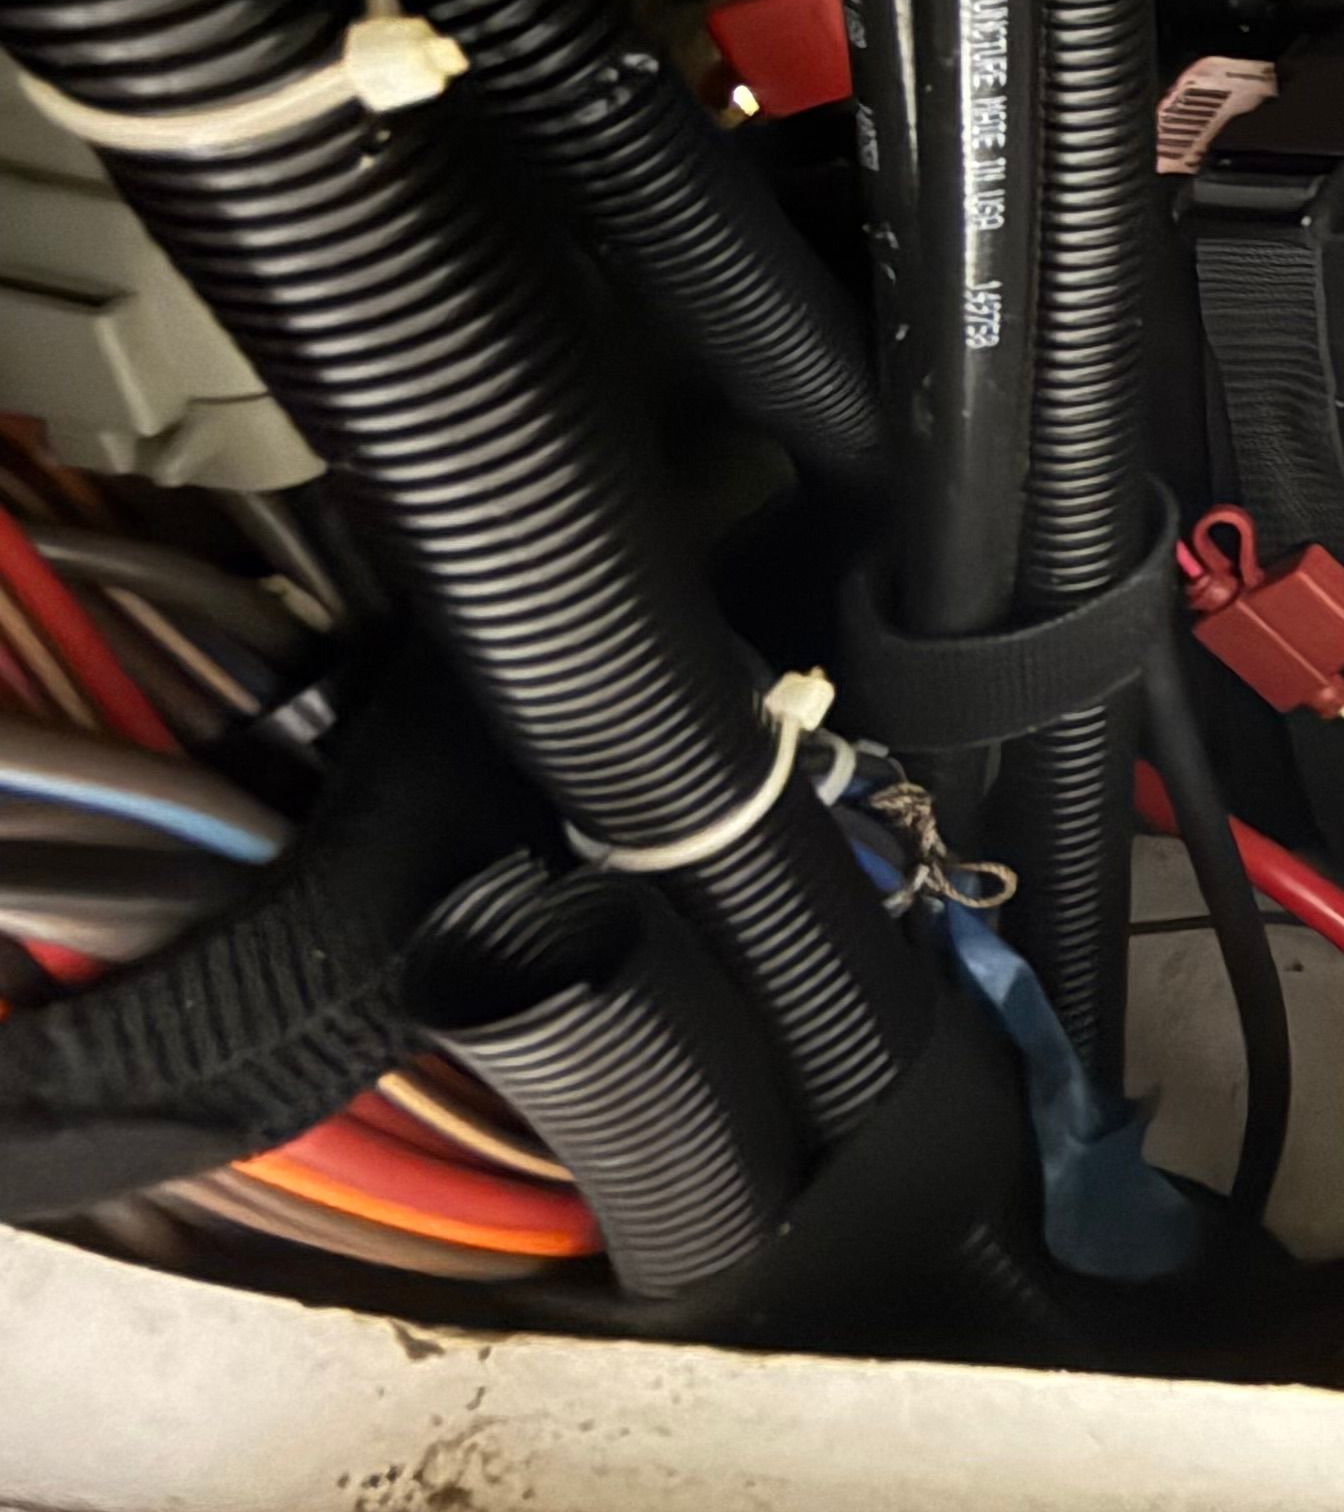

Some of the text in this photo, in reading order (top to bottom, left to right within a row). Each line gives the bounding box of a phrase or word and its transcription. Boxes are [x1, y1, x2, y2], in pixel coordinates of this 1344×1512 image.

[972, 95, 1007, 149] MADE
[970, 159, 1006, 184] IN
[971, 190, 1006, 232] USA
